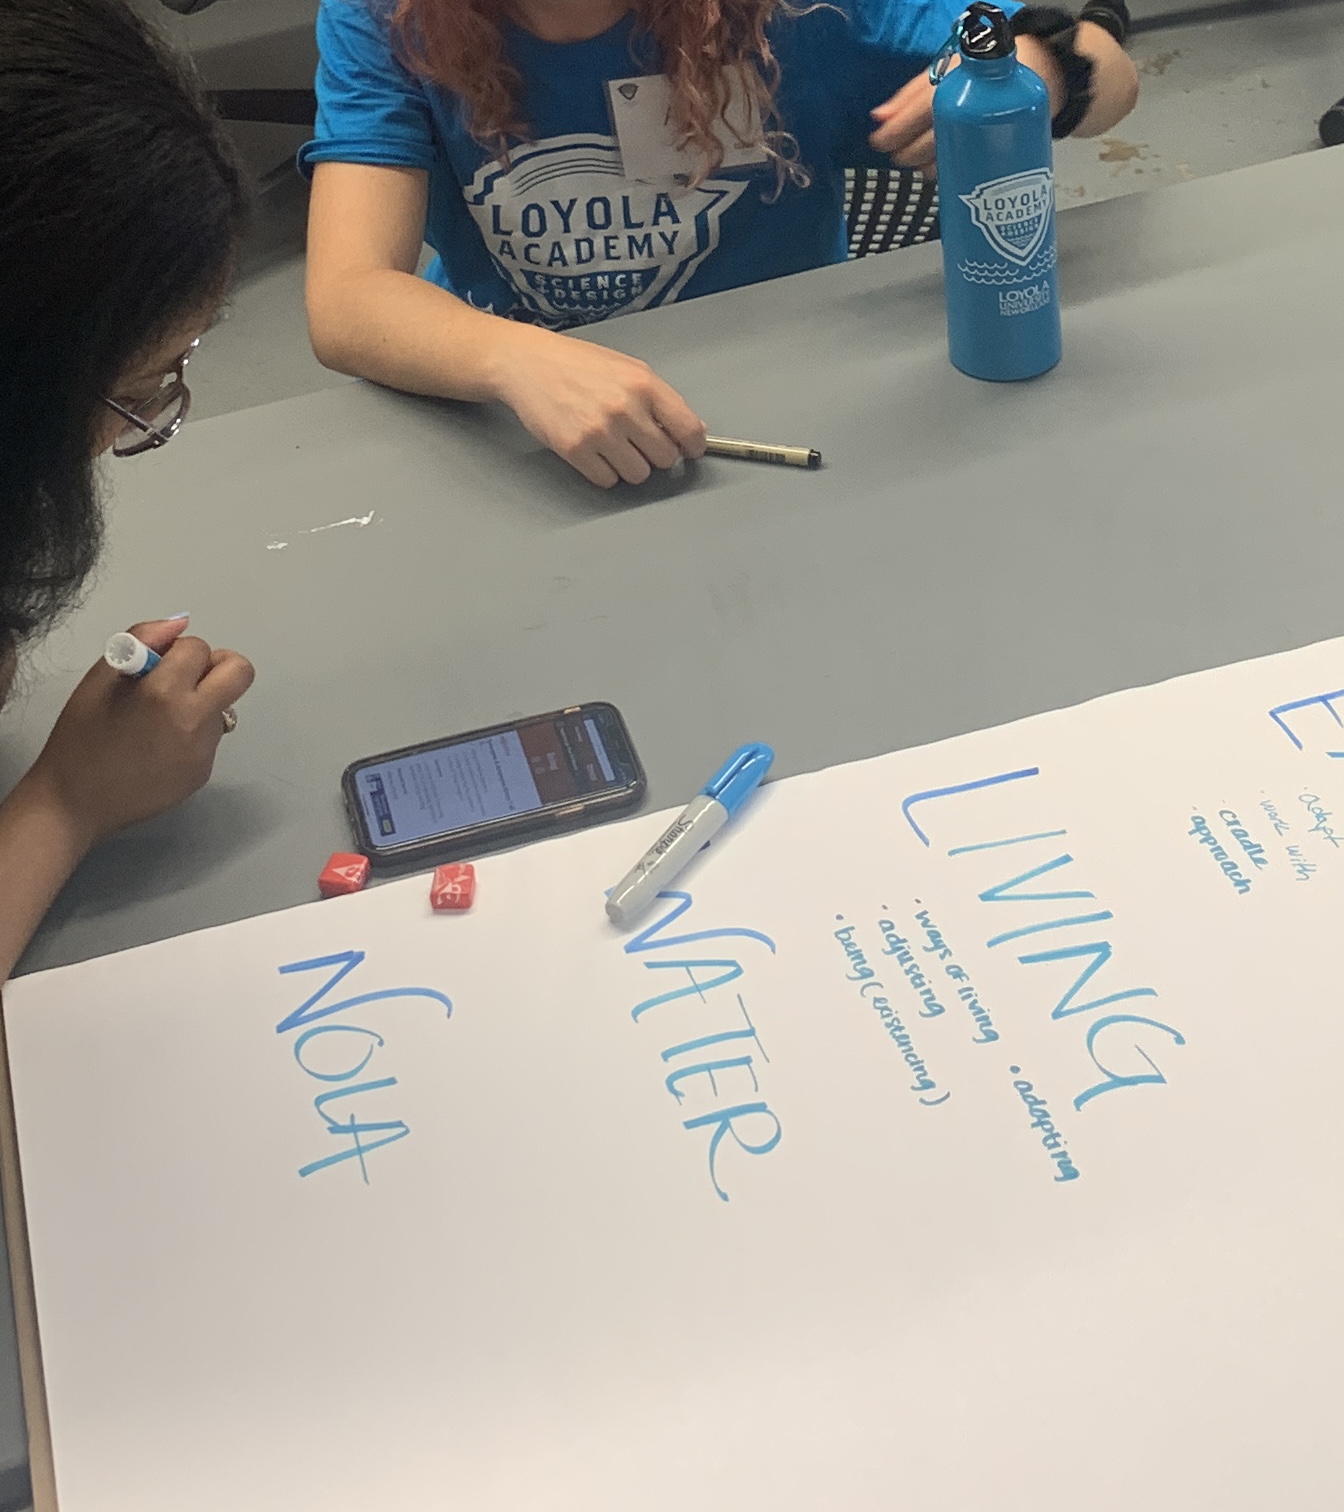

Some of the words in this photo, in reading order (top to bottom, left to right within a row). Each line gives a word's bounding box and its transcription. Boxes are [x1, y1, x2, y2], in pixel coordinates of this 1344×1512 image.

[492, 191, 681, 239] LOYOLA
[982, 183, 1048, 211] LOYOLA
[985, 198, 1047, 222] ACADEMY
[498, 230, 680, 268] ACADEMY
[534, 272, 643, 289] SCIENCE
[999, 280, 1050, 302] LOYOLA
[1187, 815, 1253, 895] approach
[1218, 809, 1270, 871] cradle
[1259, 799, 1291, 837] work
[1285, 844, 1318, 882] with
[833, 925, 876, 981] being
[877, 918, 946, 1019] adjusting
[901, 765, 1187, 1112] LIVING
[915, 909, 953, 962] ways
[944, 961, 970, 984] of
[957, 985, 1000, 1045] living
[275, 949, 454, 1187] NOLA
[1012, 1078, 1081, 1183] adapting
